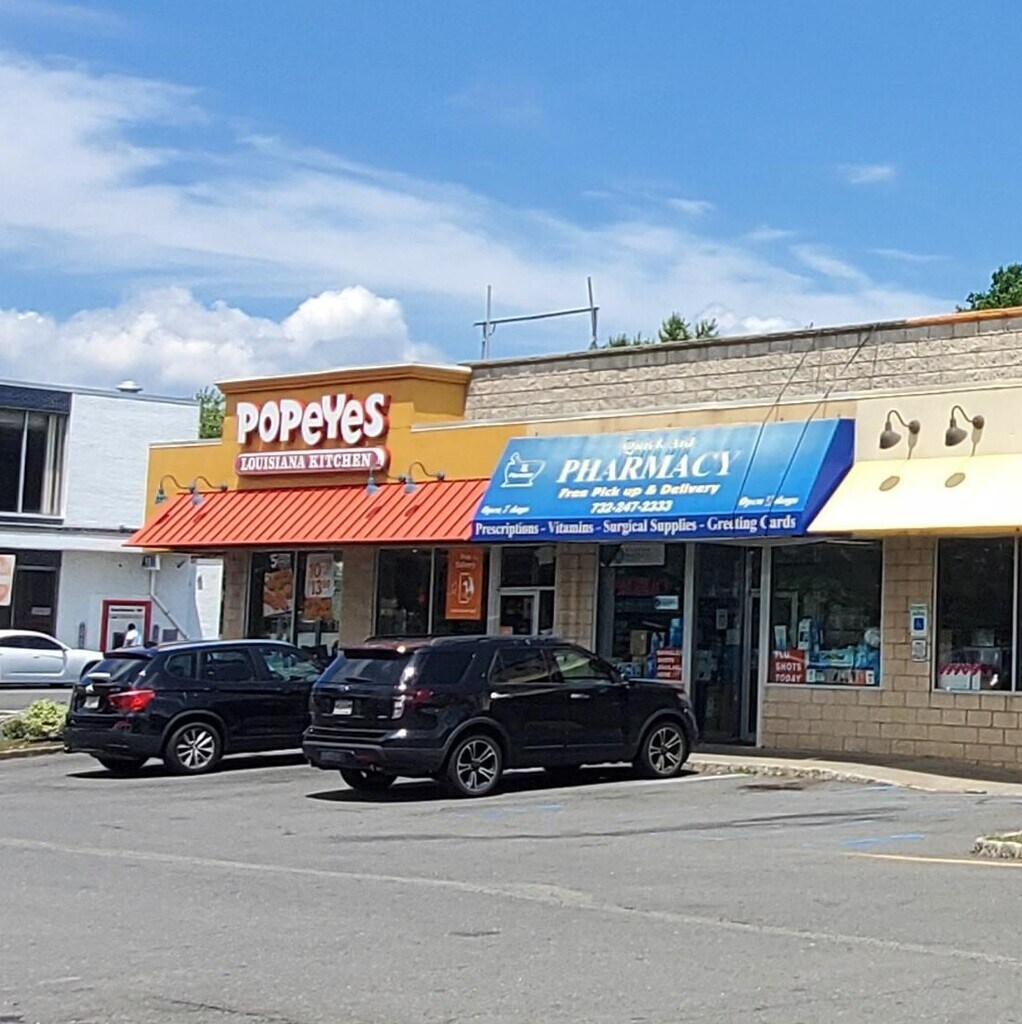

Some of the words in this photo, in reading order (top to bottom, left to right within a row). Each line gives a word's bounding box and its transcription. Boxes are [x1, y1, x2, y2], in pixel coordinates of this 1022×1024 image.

[239, 454, 306, 471] LOUISIANA
[307, 452, 370, 469] KITCHEN
[556, 449, 741, 483] PHARMACY
[558, 486, 589, 499] Free
[591, 485, 620, 497] Pick
[622, 485, 643, 498] up
[645, 483, 657, 495] &
[660, 482, 721, 495] Delivery
[475, 521, 539, 538] Prescriptions
[547, 519, 594, 535] Vitamins
[602, 518, 648, 536] Surgical
[649, 517, 697, 536] Supplies
[706, 515, 758, 533] Greeting
[759, 513, 797, 530] Cards
[775, 662, 802, 672] SHOTS
[775, 673, 802, 683] TODAY
